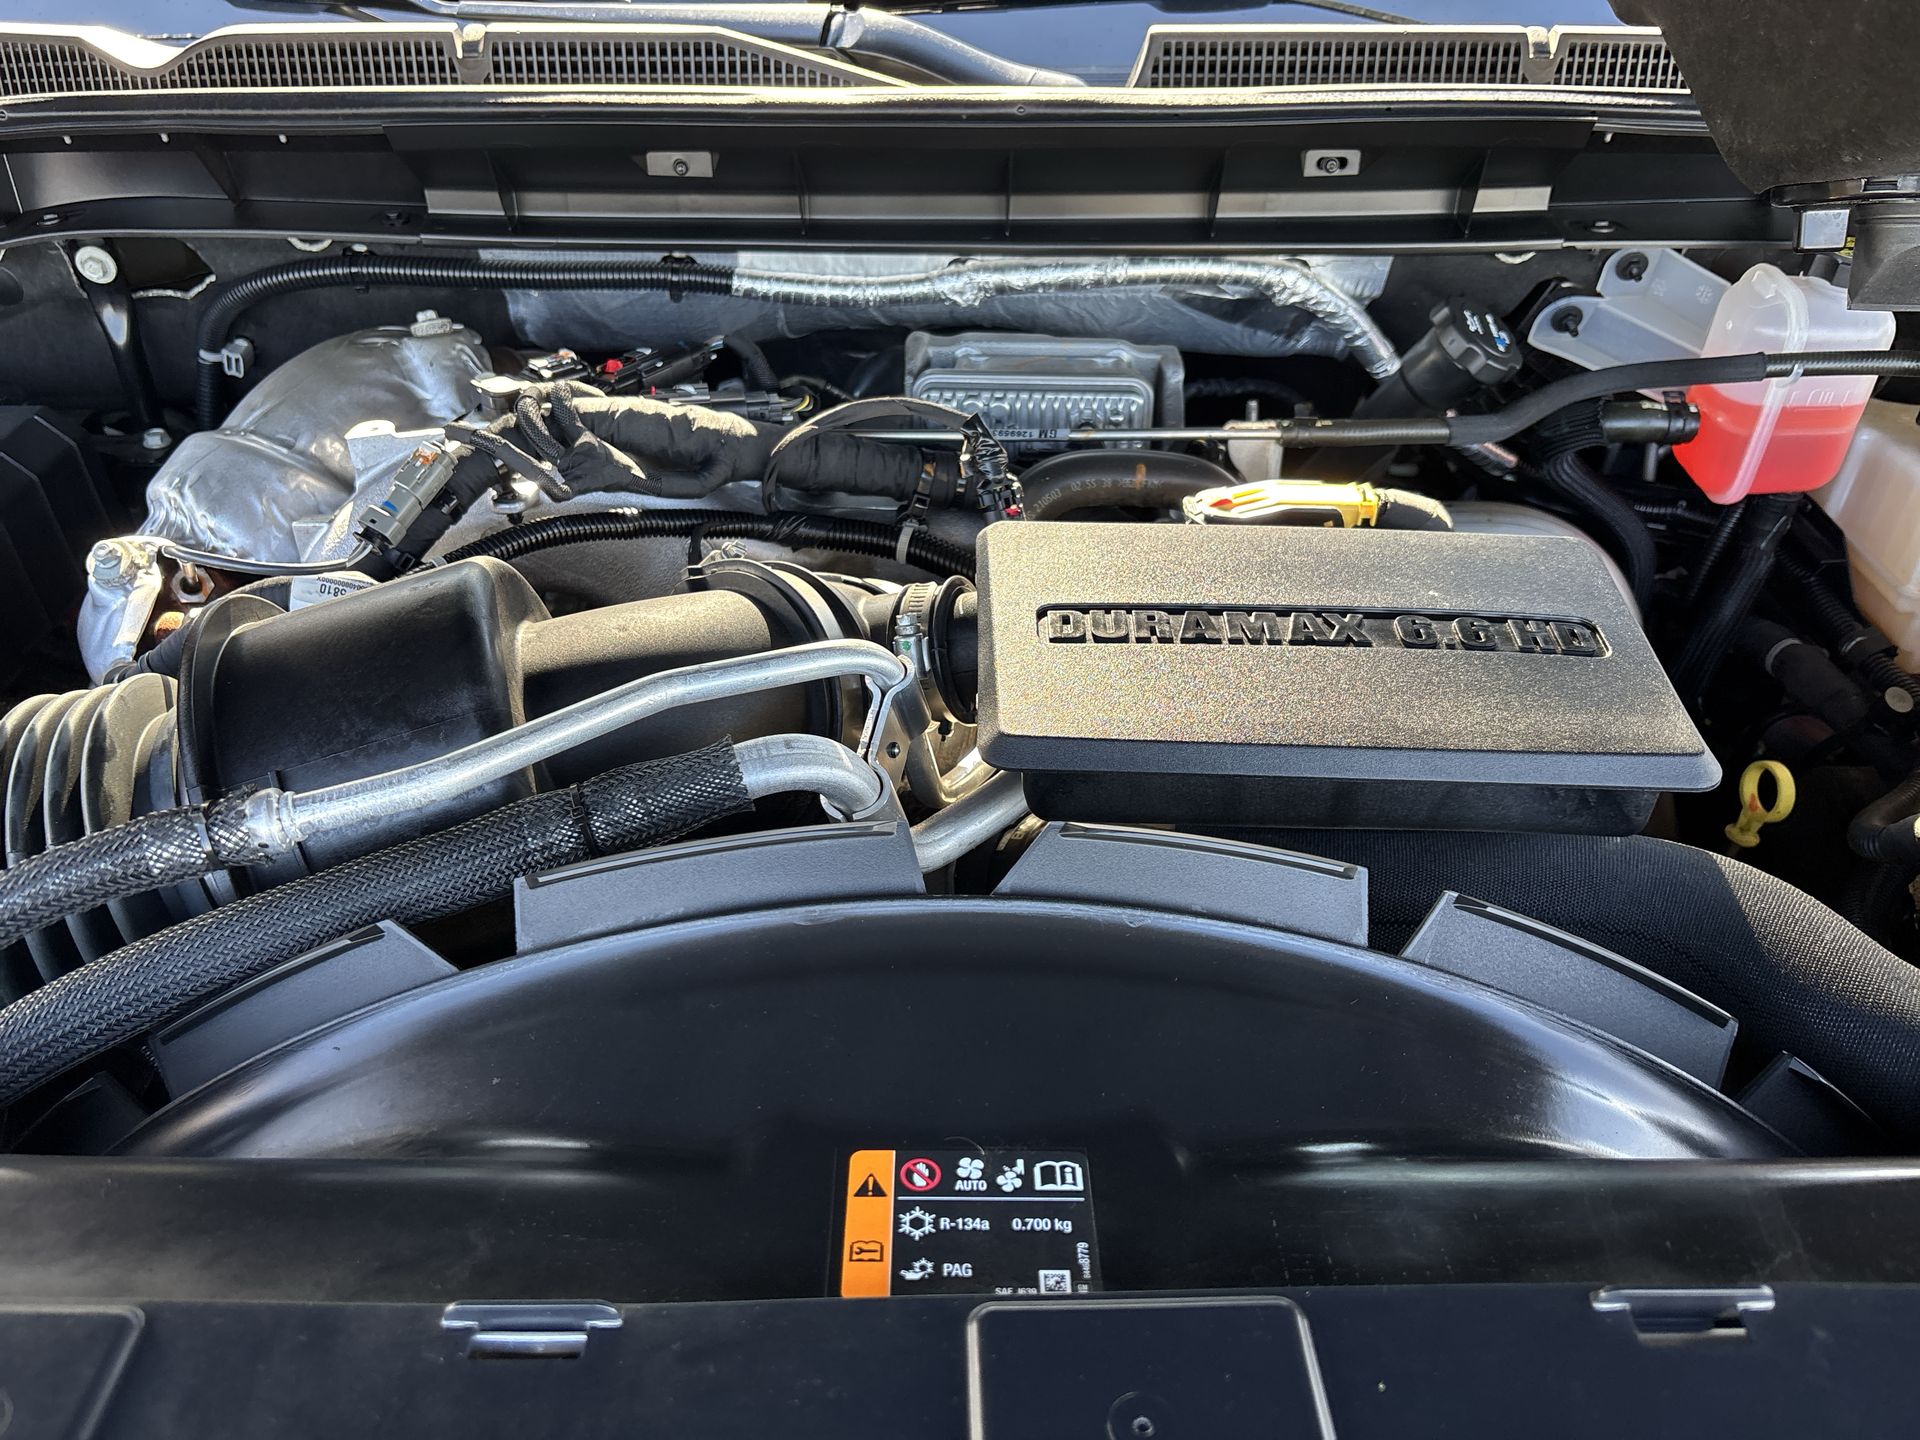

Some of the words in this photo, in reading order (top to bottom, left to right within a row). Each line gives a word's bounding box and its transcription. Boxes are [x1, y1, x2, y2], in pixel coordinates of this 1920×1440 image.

[1038, 428, 1057, 439] GM
[1047, 610, 1374, 647] DURAMAX
[1394, 614, 1498, 650] 6.6
[1506, 618, 1597, 656] HD
[954, 1180, 987, 1191] AUTO
[940, 1217, 990, 1231] R-134a
[1012, 1217, 1051, 1231] 0.700
[1054, 1217, 1072, 1234] kg
[942, 1263, 973, 1277] PAG
